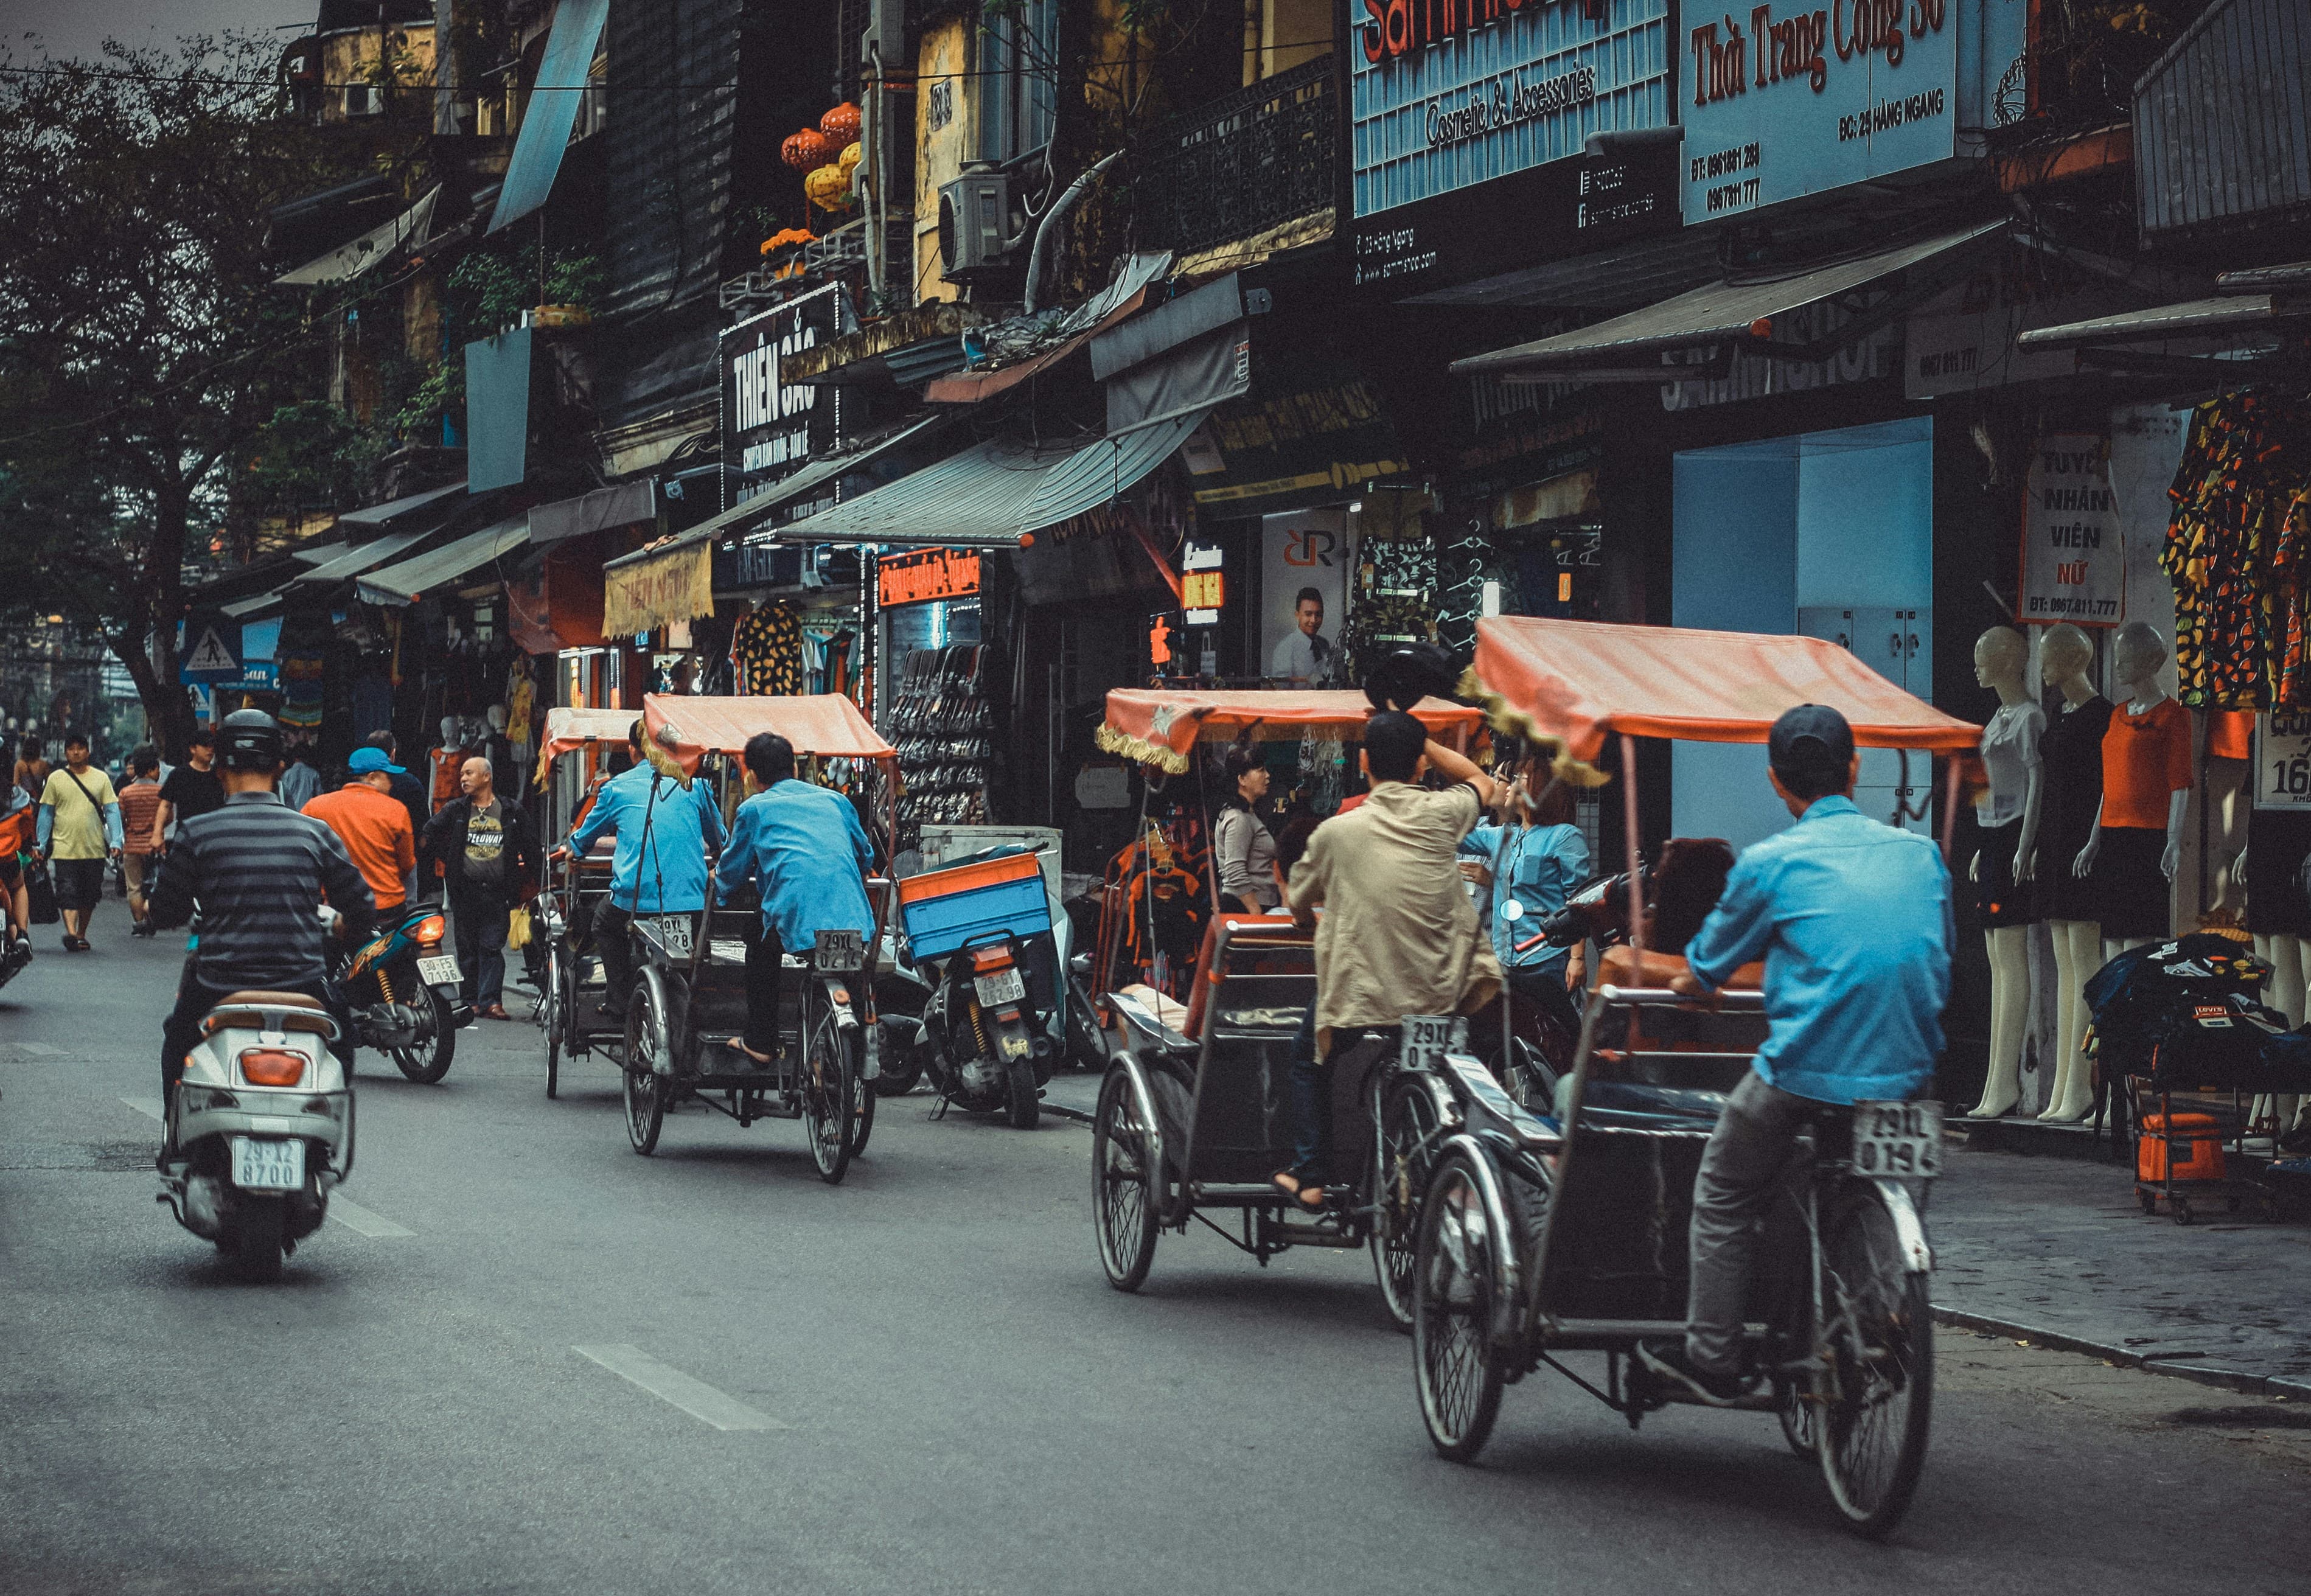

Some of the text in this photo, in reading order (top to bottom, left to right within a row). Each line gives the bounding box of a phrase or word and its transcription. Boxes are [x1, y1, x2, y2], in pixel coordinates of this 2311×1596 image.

[1751, 4, 1827, 93] Trang
[1426, 60, 1595, 147] Cosmetic & Accessories
[1838, 87, 1945, 142] ĐC: 25 HÀNG NGANG
[1690, 156, 1706, 182] ĐT:
[1743, 177, 1761, 204] 777
[734, 332, 778, 433] THIÊN
[2044, 486, 2109, 511] NHÂN
[2050, 521, 2100, 548] VIÊN
[428, 969, 457, 982] 7136
[243, 1162, 293, 1185] 8700
